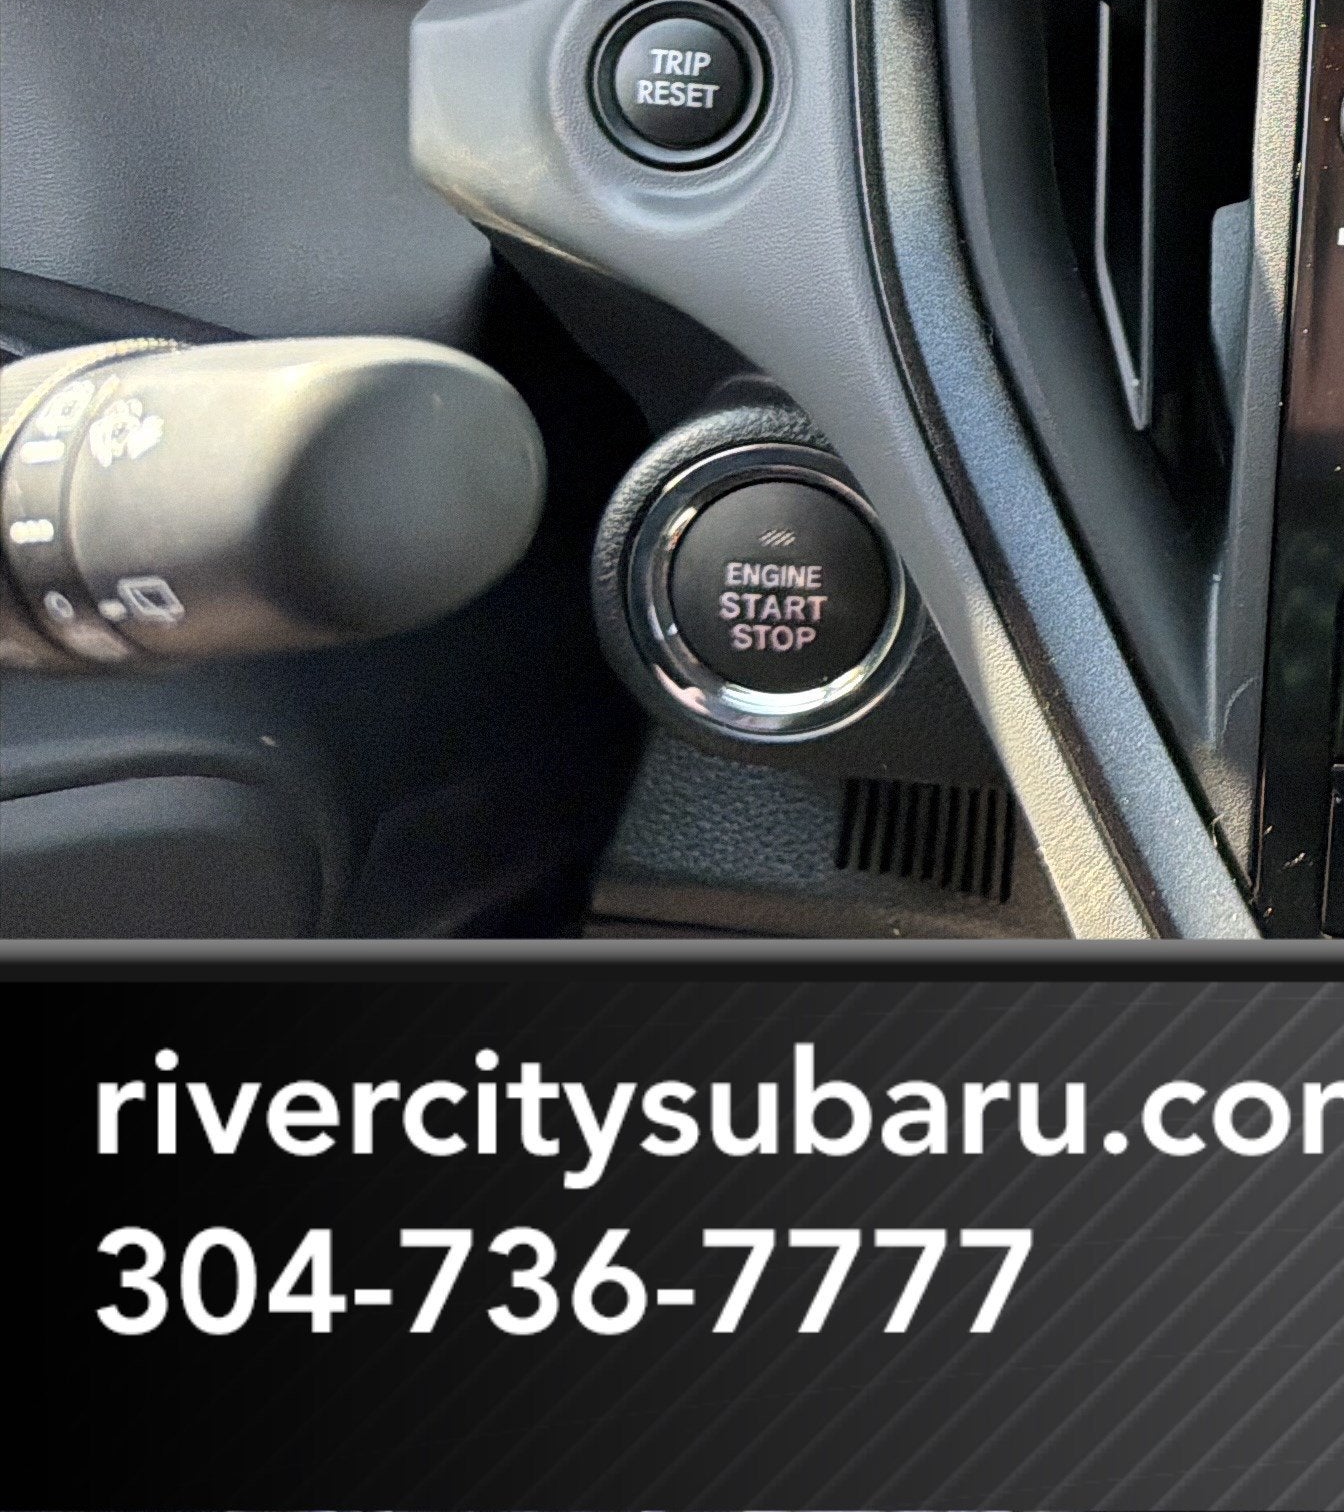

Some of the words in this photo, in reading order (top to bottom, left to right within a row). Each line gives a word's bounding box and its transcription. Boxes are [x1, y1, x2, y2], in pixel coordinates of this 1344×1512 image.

[650, 48, 712, 77] TRIP
[635, 80, 720, 110] RESET
[724, 562, 823, 589] ENGINE
[718, 592, 828, 623] START
[730, 623, 817, 653] STOP
